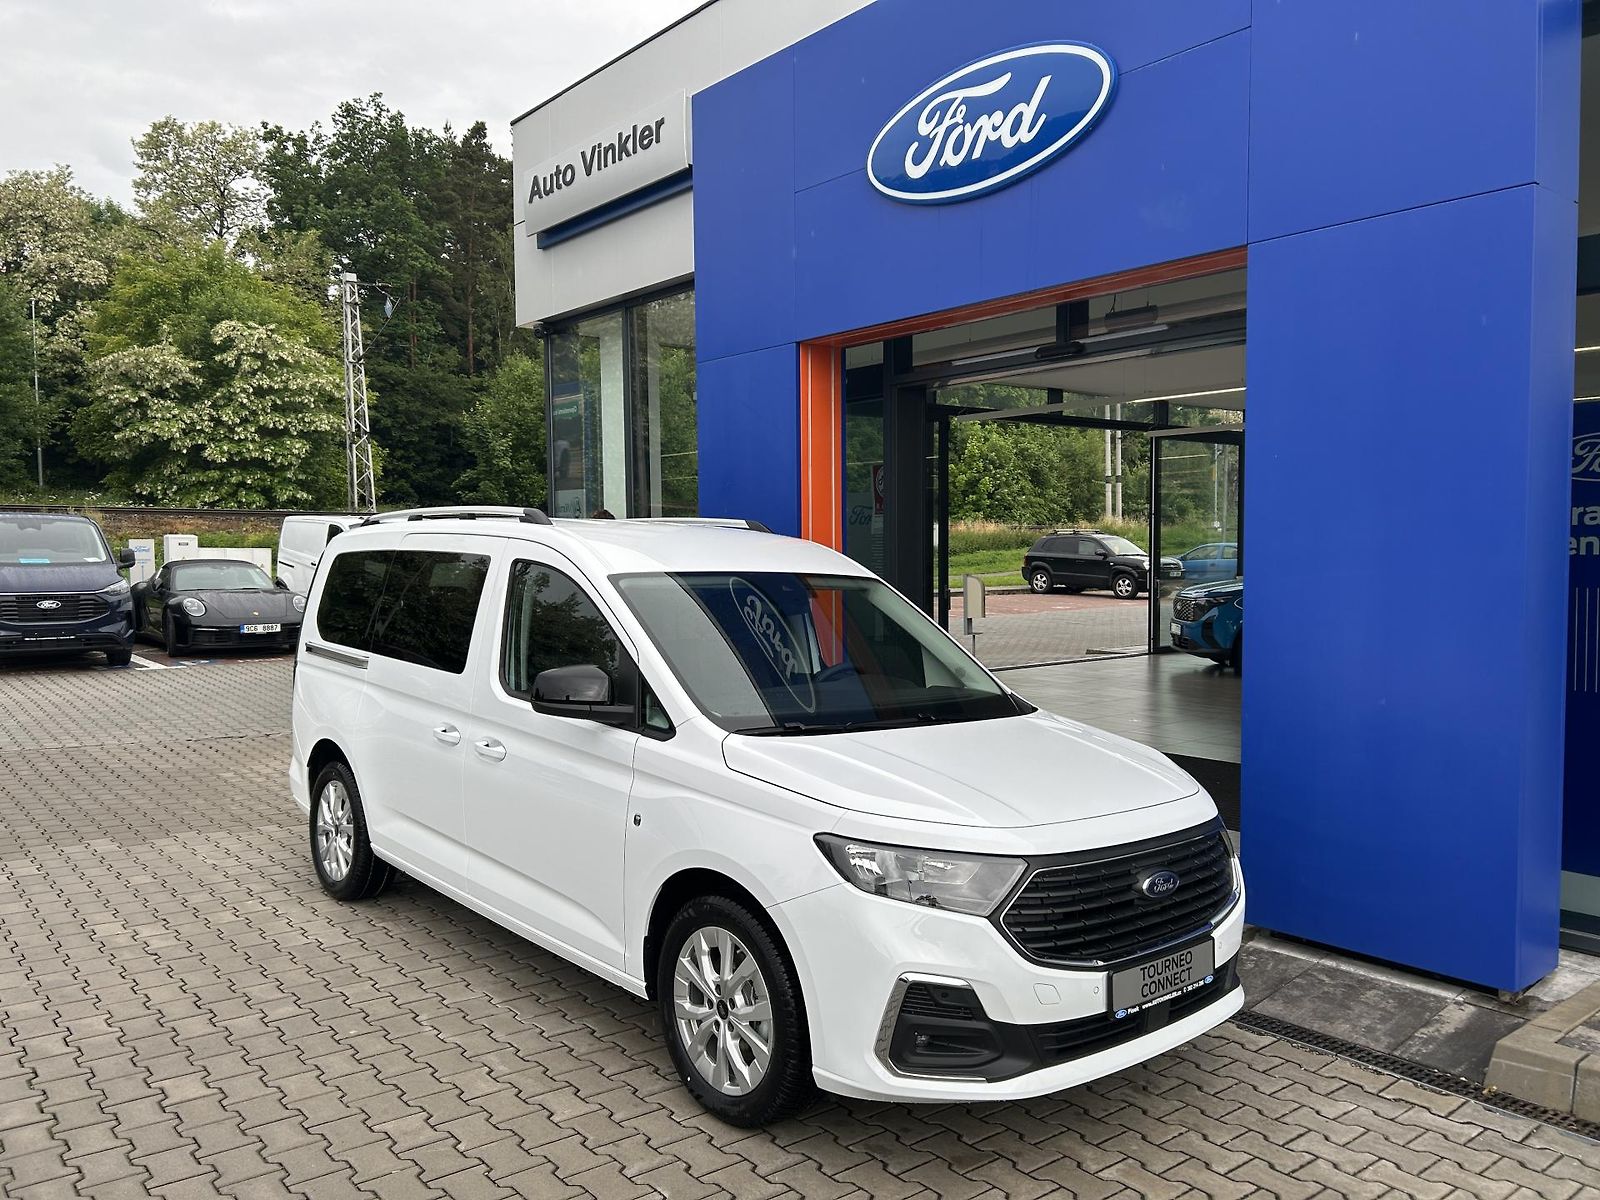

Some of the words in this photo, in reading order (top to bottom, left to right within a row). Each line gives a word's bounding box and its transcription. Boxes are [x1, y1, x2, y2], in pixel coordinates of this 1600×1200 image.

[904, 71, 1052, 179] Ford
[528, 162, 576, 204] Auto
[580, 117, 665, 177] Vinkler
[1153, 877, 1175, 893] Ford
[1140, 951, 1193, 979] TOURNEO
[1140, 966, 1193, 998] CONNECT
